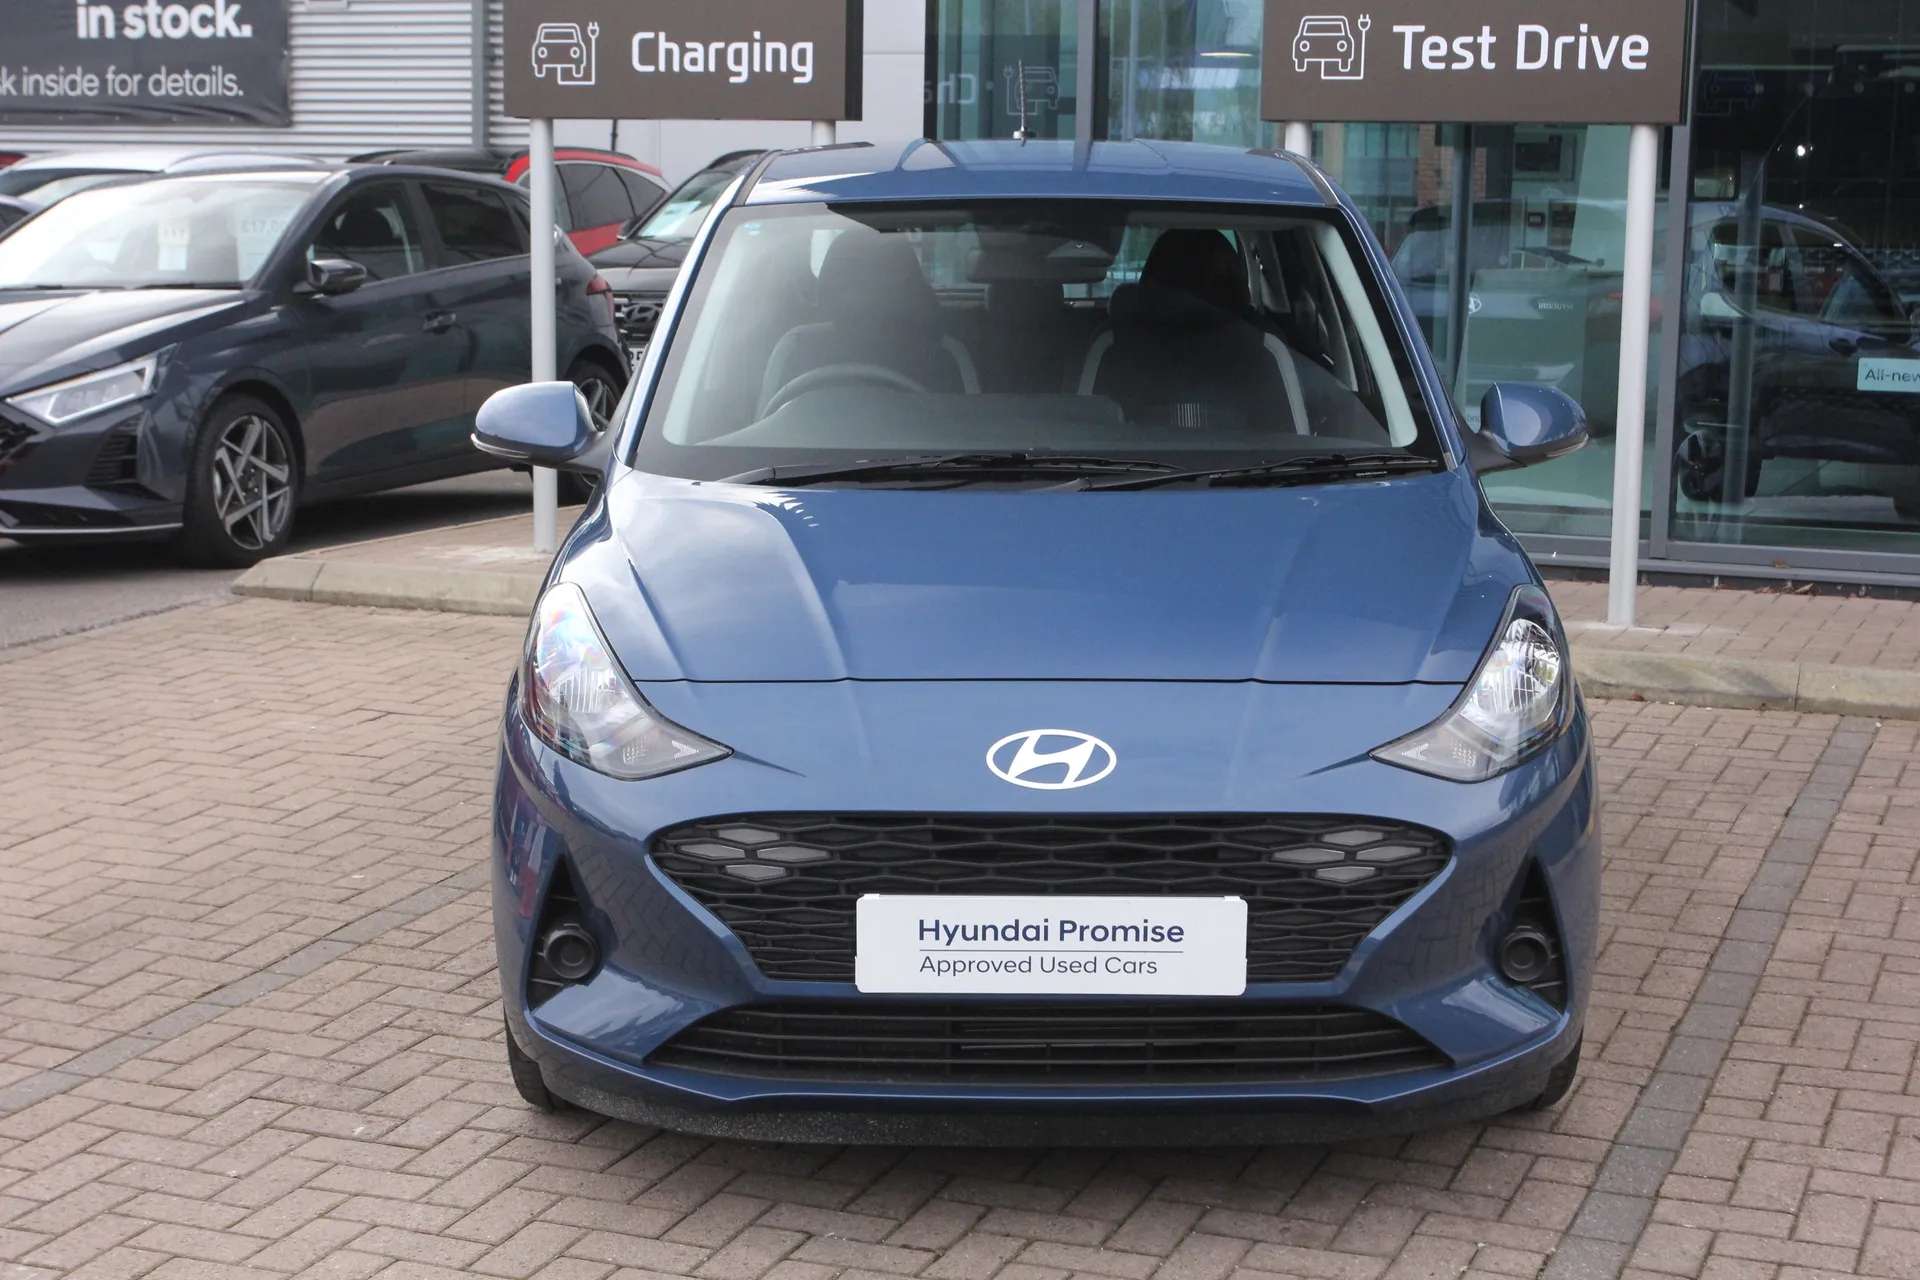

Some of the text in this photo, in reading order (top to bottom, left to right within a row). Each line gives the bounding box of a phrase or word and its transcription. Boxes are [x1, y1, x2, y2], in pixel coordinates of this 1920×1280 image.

[77, 0, 253, 39] in stock.
[631, 31, 813, 83] Charging
[1393, 23, 1649, 70] Test Drive
[22, 66, 99, 96] inside
[105, 65, 143, 96] for
[148, 66, 244, 96] details.
[919, 918, 1184, 946] Hyundai Promise
[919, 956, 1158, 976] Approved Used Cars
